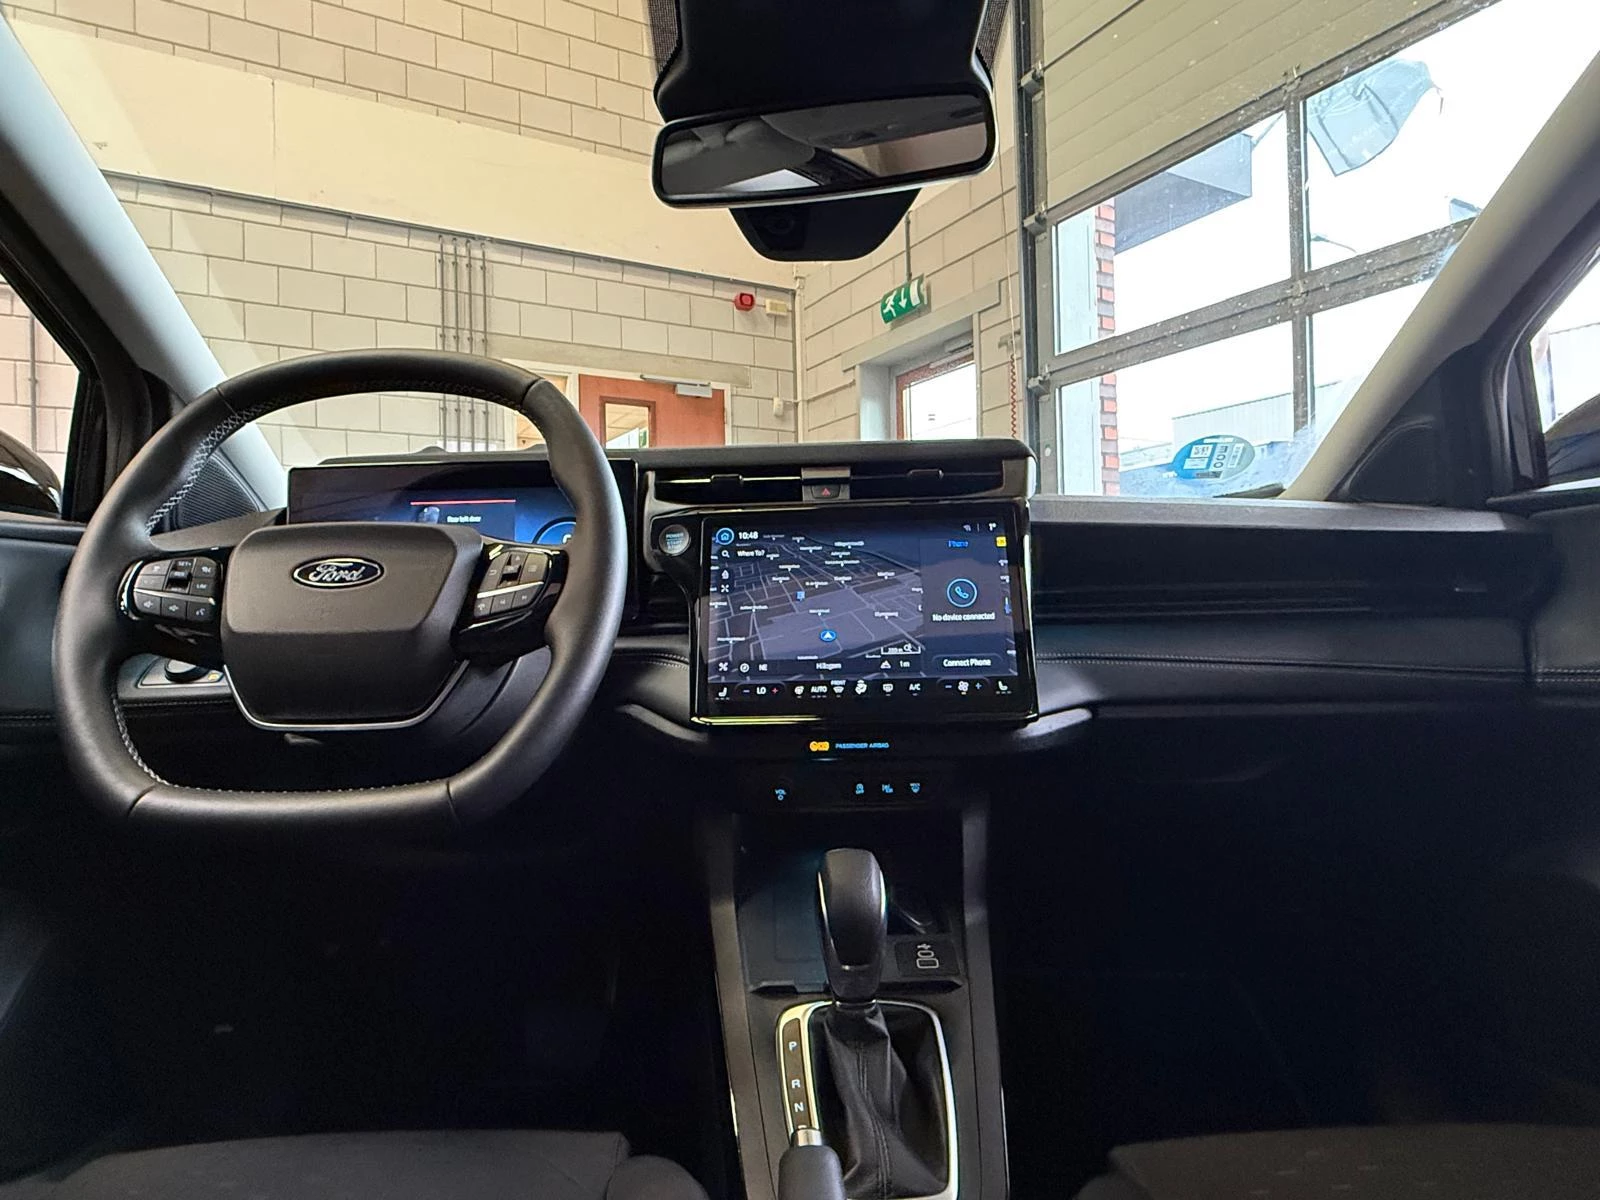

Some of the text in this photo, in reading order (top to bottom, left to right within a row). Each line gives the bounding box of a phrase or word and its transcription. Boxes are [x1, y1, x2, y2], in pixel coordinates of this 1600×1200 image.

[738, 531, 759, 540] 10:48
[948, 540, 969, 548] Phone
[755, 549, 765, 557] To?
[308, 562, 365, 581] Ford
[932, 612, 996, 622] No device connected
[943, 658, 992, 667] Connect Phone
[810, 685, 828, 693] AUTO
[908, 683, 921, 691] A/C
[788, 1041, 798, 1051] P
[791, 1079, 801, 1089] R
[794, 1102, 804, 1112] N
